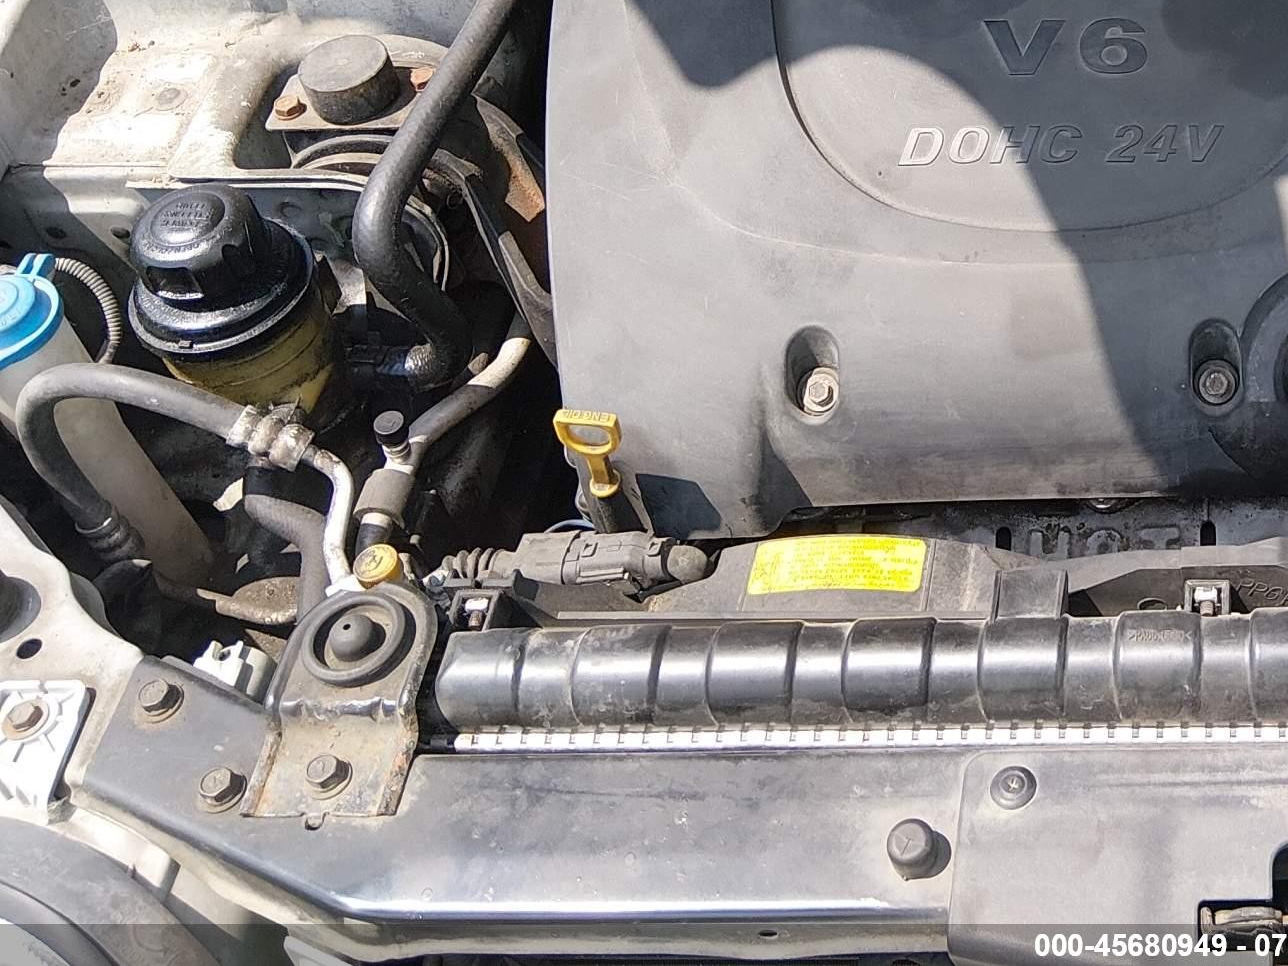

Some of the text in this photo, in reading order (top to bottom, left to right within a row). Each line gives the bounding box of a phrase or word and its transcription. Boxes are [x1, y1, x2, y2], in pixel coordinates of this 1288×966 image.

[981, 16, 1149, 76] V6
[897, 123, 1225, 167] DOHC 24V
[583, 410, 609, 422] ENG
